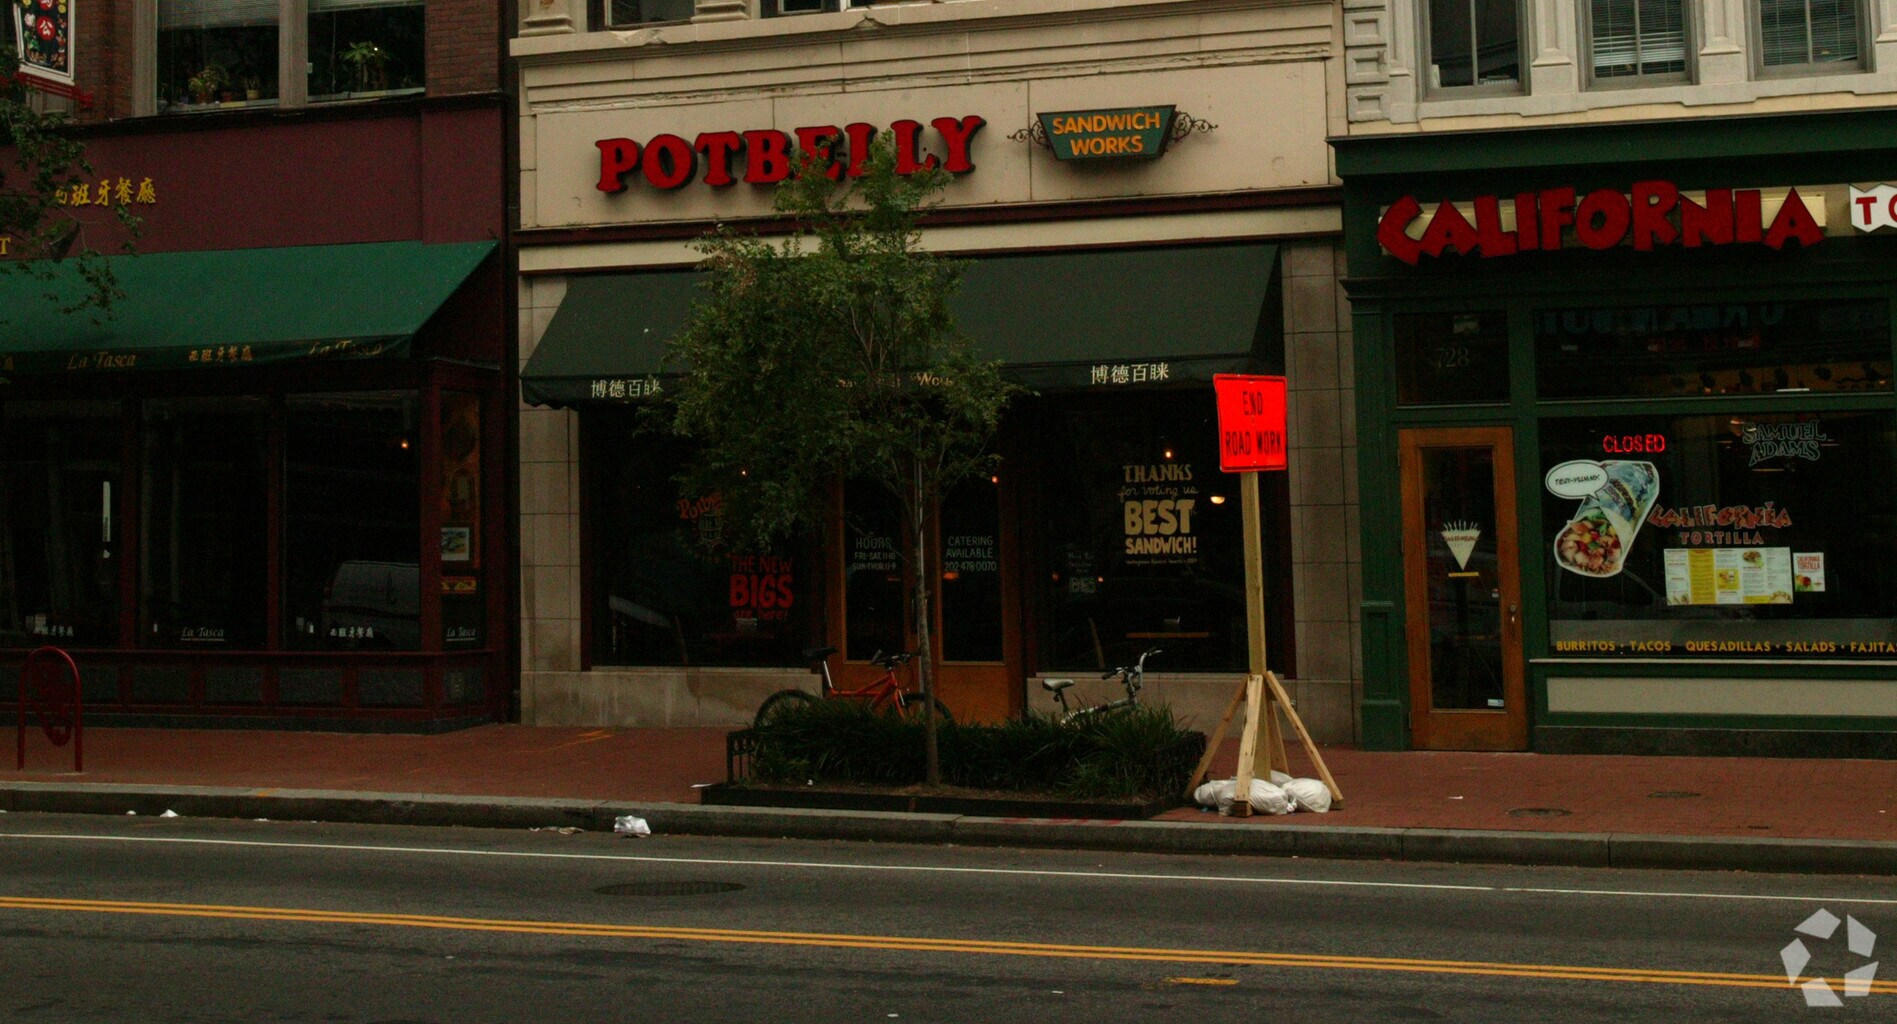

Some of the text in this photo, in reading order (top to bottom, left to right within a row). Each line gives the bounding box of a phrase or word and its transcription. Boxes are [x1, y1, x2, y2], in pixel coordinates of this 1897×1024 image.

[1052, 111, 1161, 135] SANDWICH
[596, 114, 985, 193] POTBELLY
[1070, 135, 1144, 156] WORKS
[1376, 179, 1826, 266] CALIFORNIA
[66, 351, 138, 370] La Tasca
[1242, 390, 1263, 416] END
[1225, 428, 1282, 457] ROAD WORK
[1741, 419, 1828, 445] SAMUEL
[1602, 432, 1667, 454] CLOSED
[1749, 439, 1822, 467] ADAMS
[1122, 462, 1193, 483] THANKS
[1143, 485, 1179, 500] voting
[1124, 499, 1195, 535] BEST
[1647, 501, 1793, 529] CALIFORNIA
[855, 537, 892, 550] HOURS
[947, 535, 994, 547] CATERING
[1125, 536, 1198, 555] SANDWICH!
[1679, 531, 1765, 545] TORTILLA
[731, 554, 755, 573] THE
[759, 553, 795, 574] NEW
[945, 547, 993, 559] AVAILABLE
[729, 573, 795, 609] BIGS
[198, 626, 225, 638] Tasca
[1556, 640, 1616, 652] BURRITOS
[1630, 640, 1672, 652] TACOS
[1685, 640, 1771, 652] QUESADILLAS
[1785, 641, 1837, 653] SALADS
